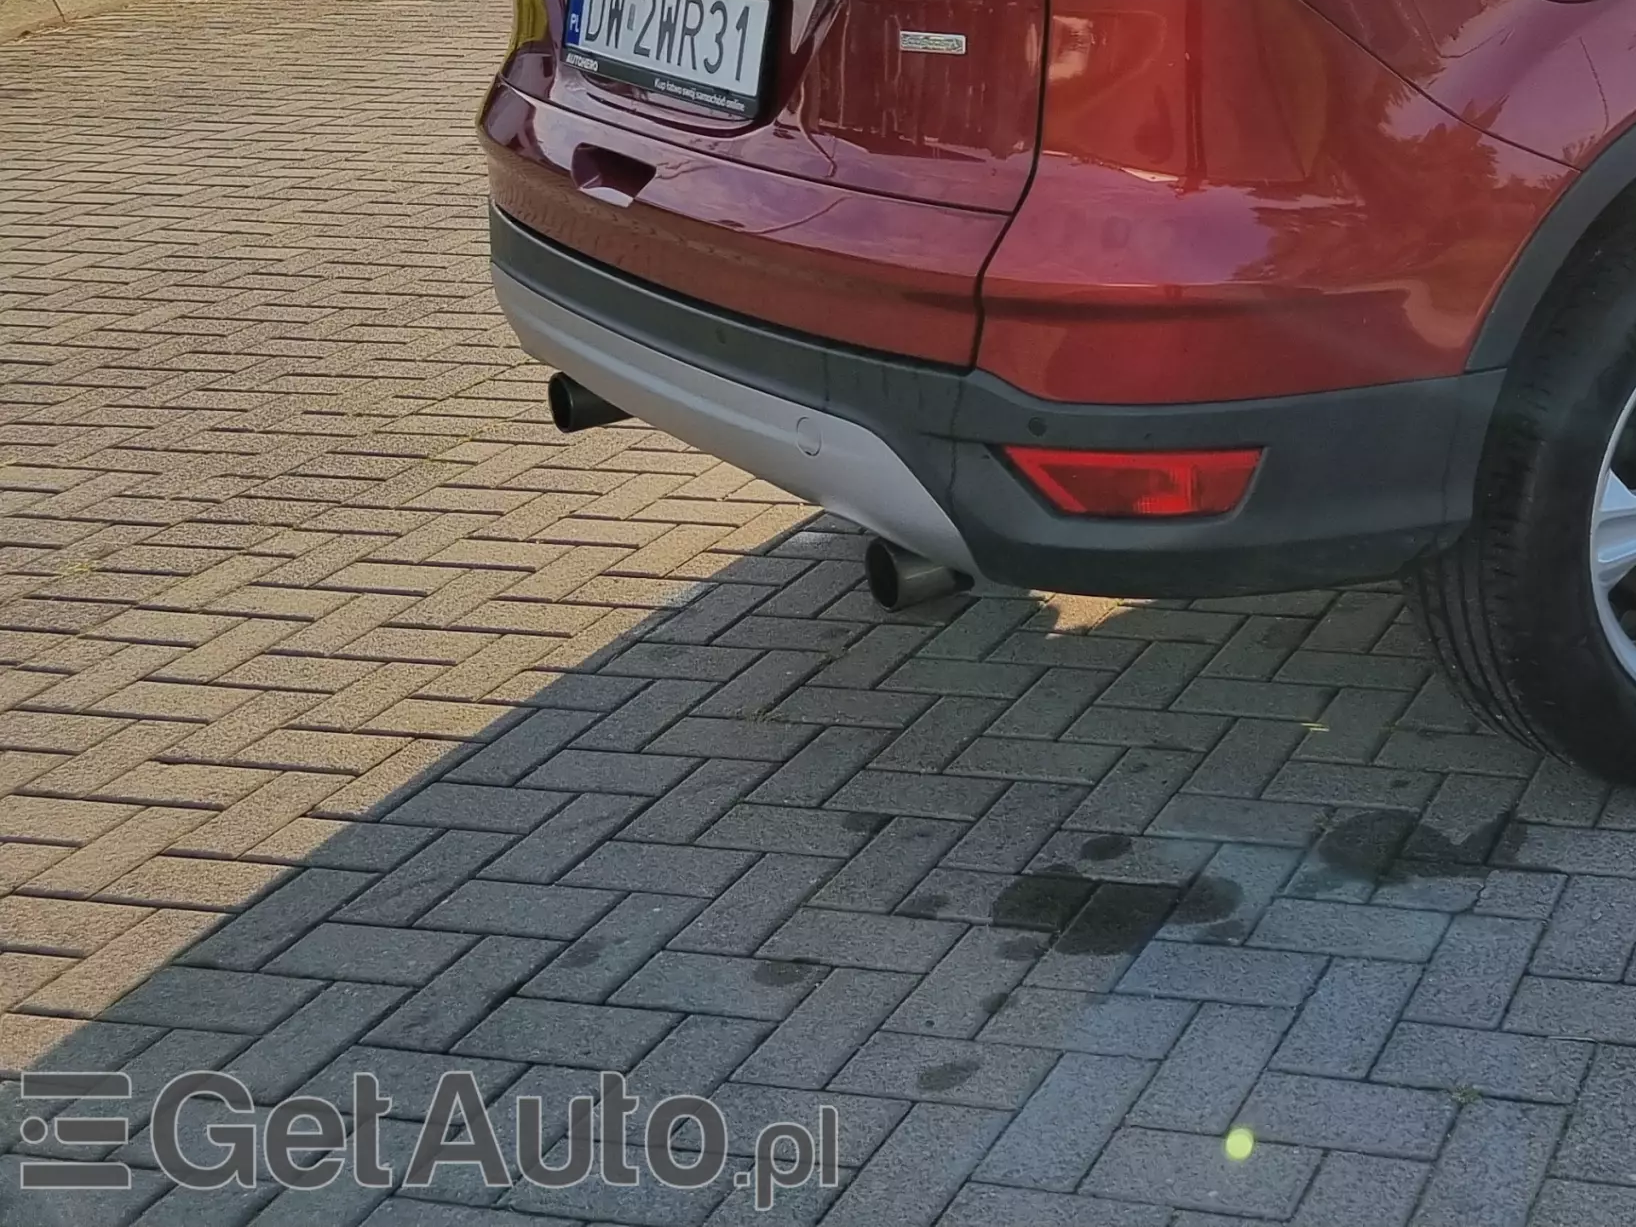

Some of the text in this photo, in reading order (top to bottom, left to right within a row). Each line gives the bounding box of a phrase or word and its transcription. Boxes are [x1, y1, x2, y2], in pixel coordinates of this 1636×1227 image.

[569, 12, 580, 33] PL
[565, 53, 599, 72] AUTOHERO
[696, 91, 726, 107] samochód
